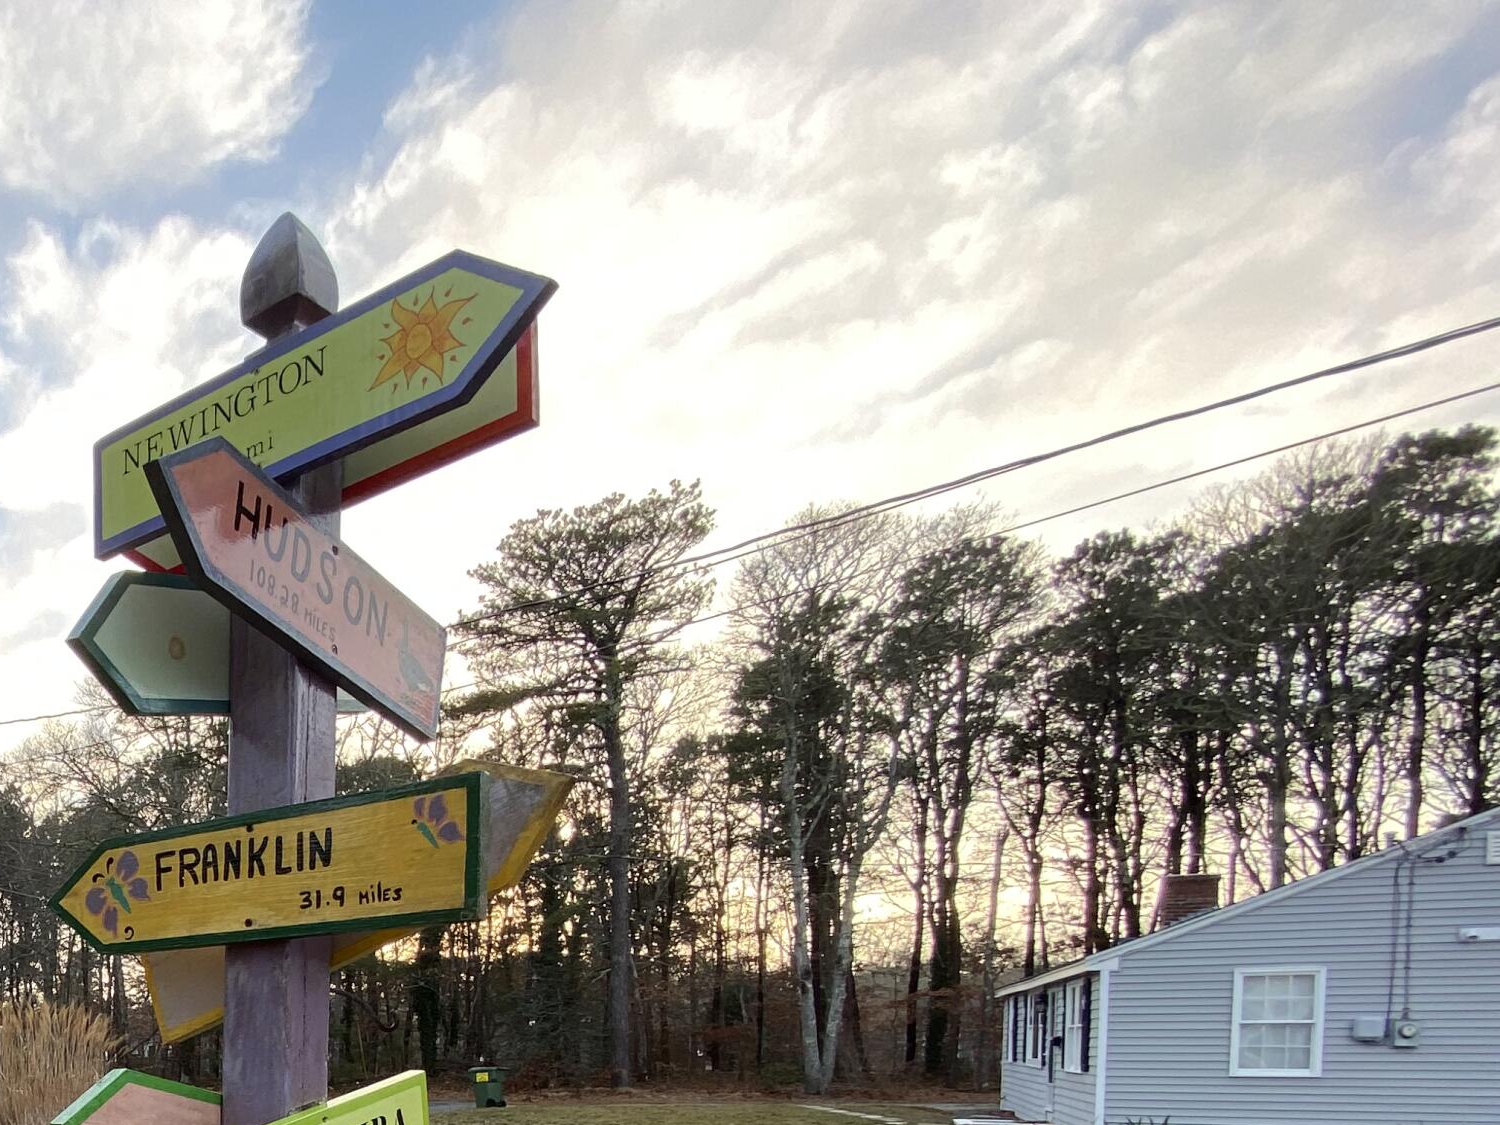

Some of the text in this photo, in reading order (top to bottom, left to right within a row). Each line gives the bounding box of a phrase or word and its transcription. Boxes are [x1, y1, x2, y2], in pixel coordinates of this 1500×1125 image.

[121, 344, 328, 476] NEWINGTON
[246, 429, 273, 459] mi
[233, 480, 389, 647] HUDSON
[155, 827, 333, 892] FRANKLIN
[299, 886, 345, 910] 31.9
